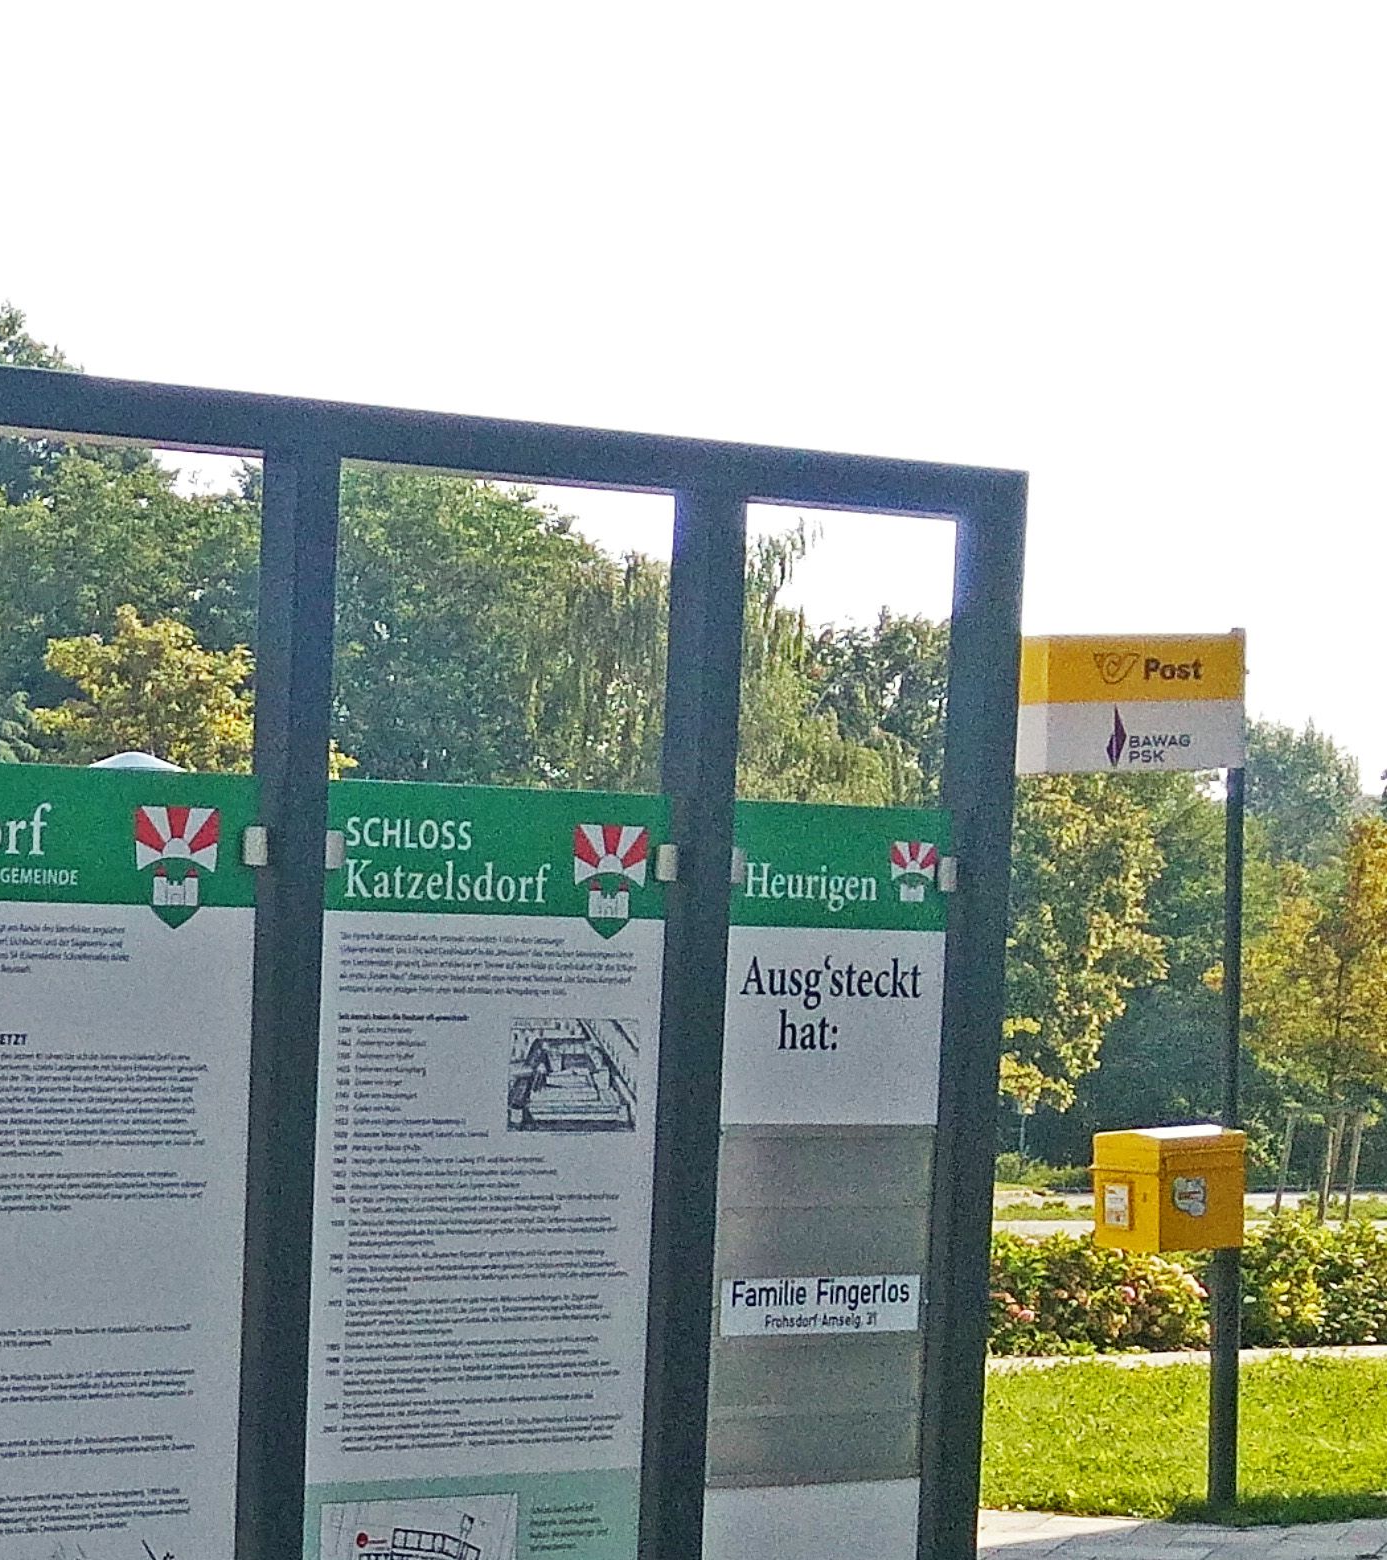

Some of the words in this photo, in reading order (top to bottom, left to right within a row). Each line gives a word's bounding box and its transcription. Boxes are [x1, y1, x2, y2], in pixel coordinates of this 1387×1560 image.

[1142, 657, 1204, 681] Post
[1128, 733, 1192, 749] BAWAG
[1128, 750, 1165, 763] PSK
[345, 816, 473, 850] SCHLOSS
[344, 858, 552, 904] Katzelsdorf
[744, 861, 877, 912] Heurigen
[778, 1008, 838, 1051] hat:
[731, 1280, 807, 1308] Familie
[816, 1277, 910, 1310] Fingerlos
